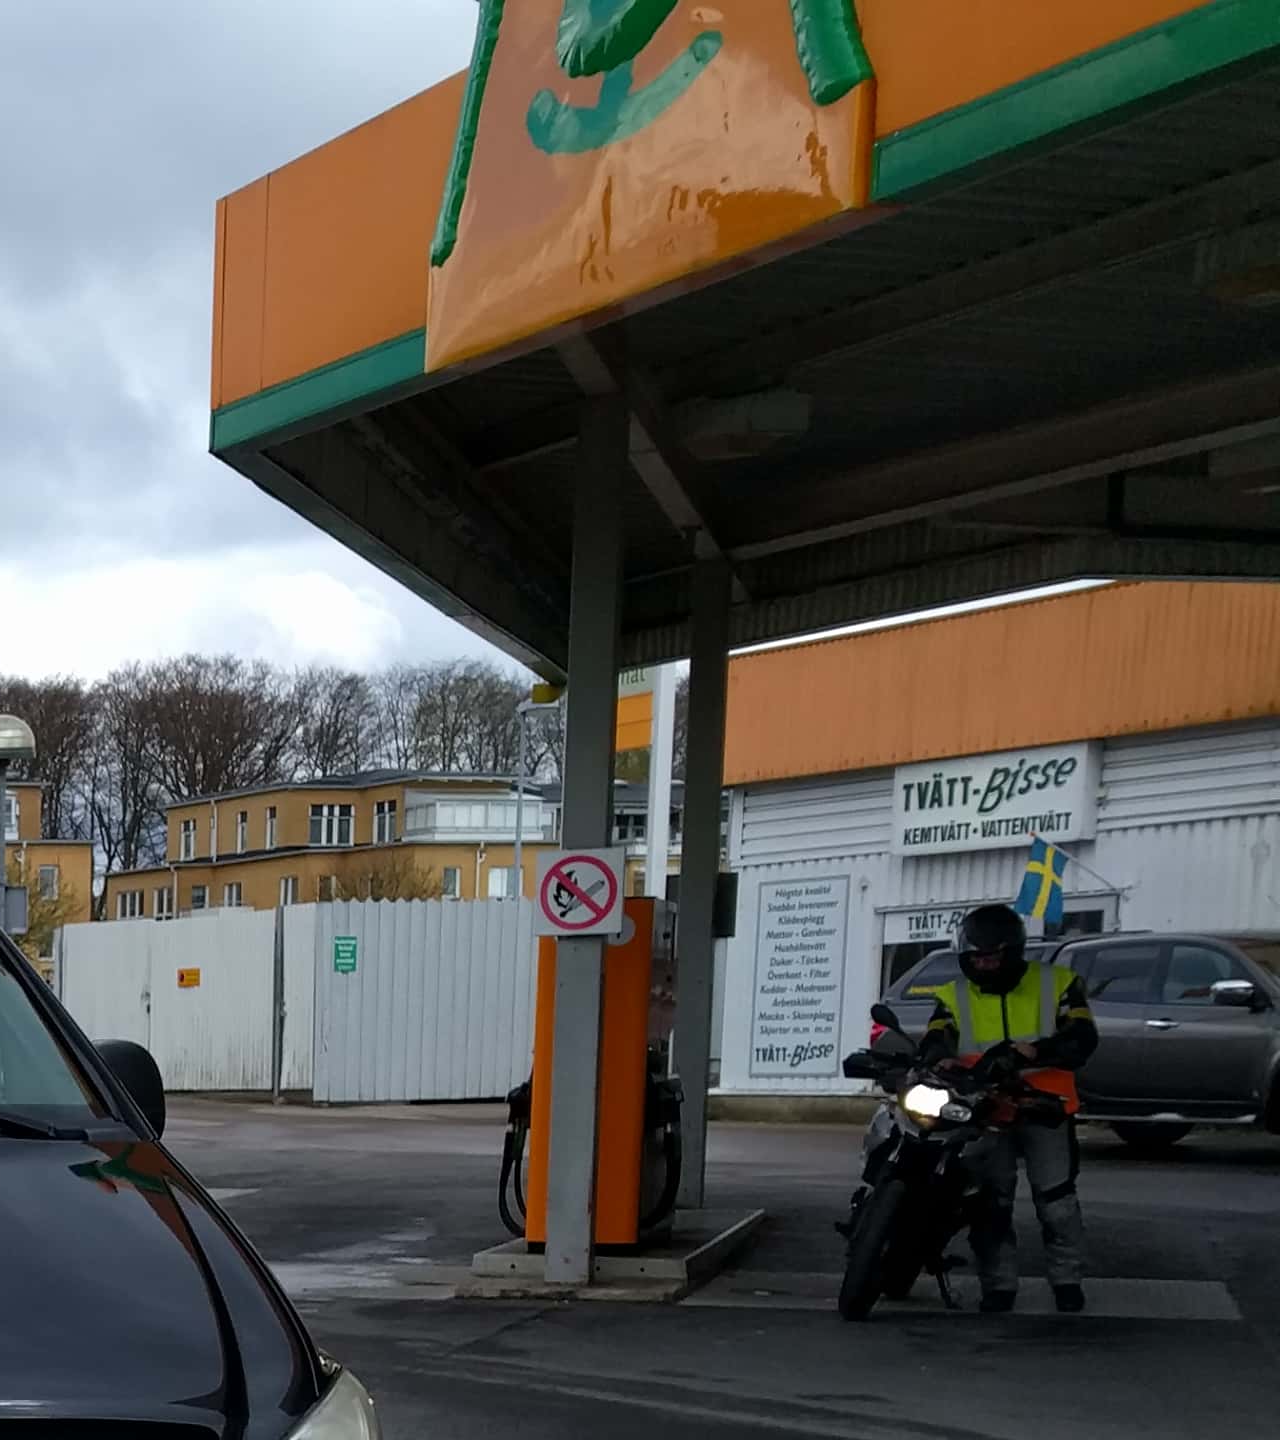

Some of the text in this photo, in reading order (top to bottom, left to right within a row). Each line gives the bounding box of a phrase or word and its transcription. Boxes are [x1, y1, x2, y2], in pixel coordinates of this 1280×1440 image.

[903, 756, 1077, 814] TVÄTT-Bisse
[903, 810, 1072, 845] KEMTVÄTT VATTENTVÄTT
[755, 1041, 834, 1067] TVÄTT-Bisse
